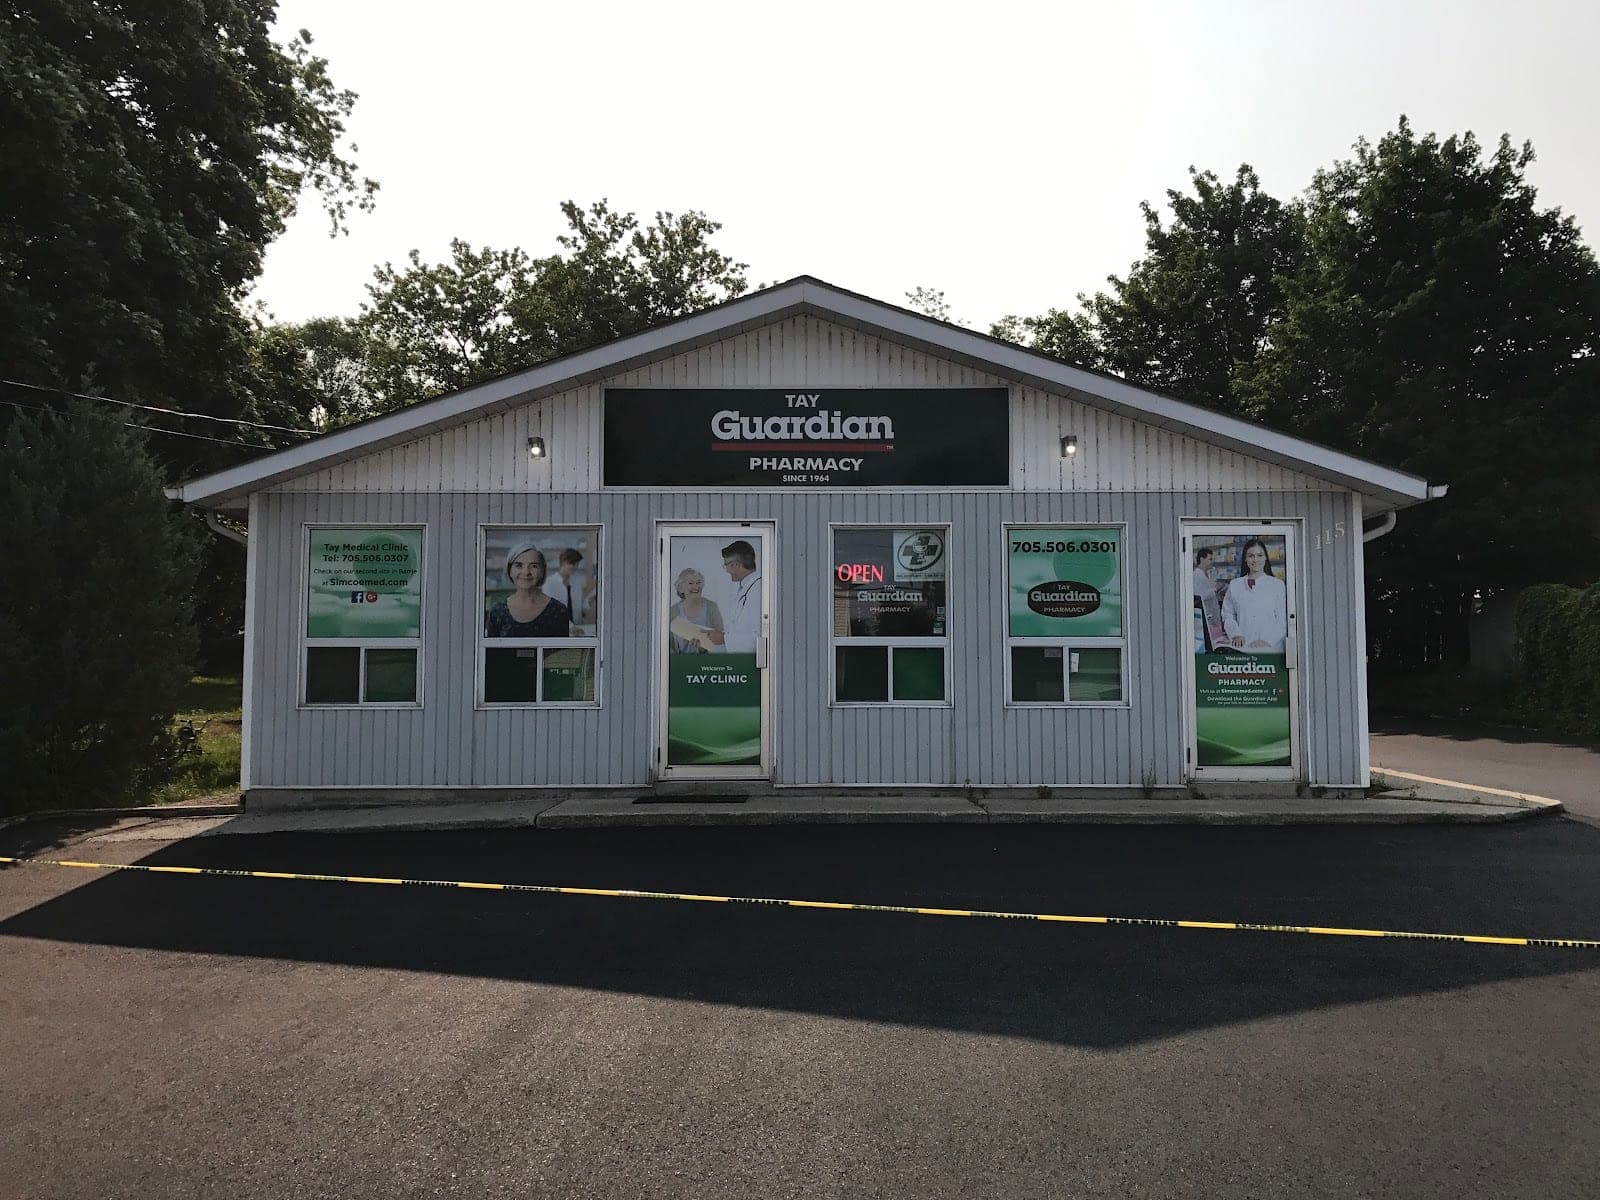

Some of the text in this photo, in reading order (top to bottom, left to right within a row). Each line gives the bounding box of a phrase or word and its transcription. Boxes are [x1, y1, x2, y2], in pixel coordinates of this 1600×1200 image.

[785, 394, 820, 408] TAY
[711, 410, 895, 440] Guardian
[749, 457, 863, 471] PHARMACY
[323, 543, 408, 552] Tay Medical Clinic
[1012, 541, 1117, 553] 705.506.0301
[323, 554, 409, 562] Tel: 705.506.0307
[837, 563, 885, 582] OPEN
[330, 578, 408, 586] Simcoemed.com
[857, 591, 923, 602] Guardian
[1030, 591, 1098, 602] Guardian
[1207, 662, 1276, 674] Guardian
[686, 674, 748, 683] TAY CLINIC
